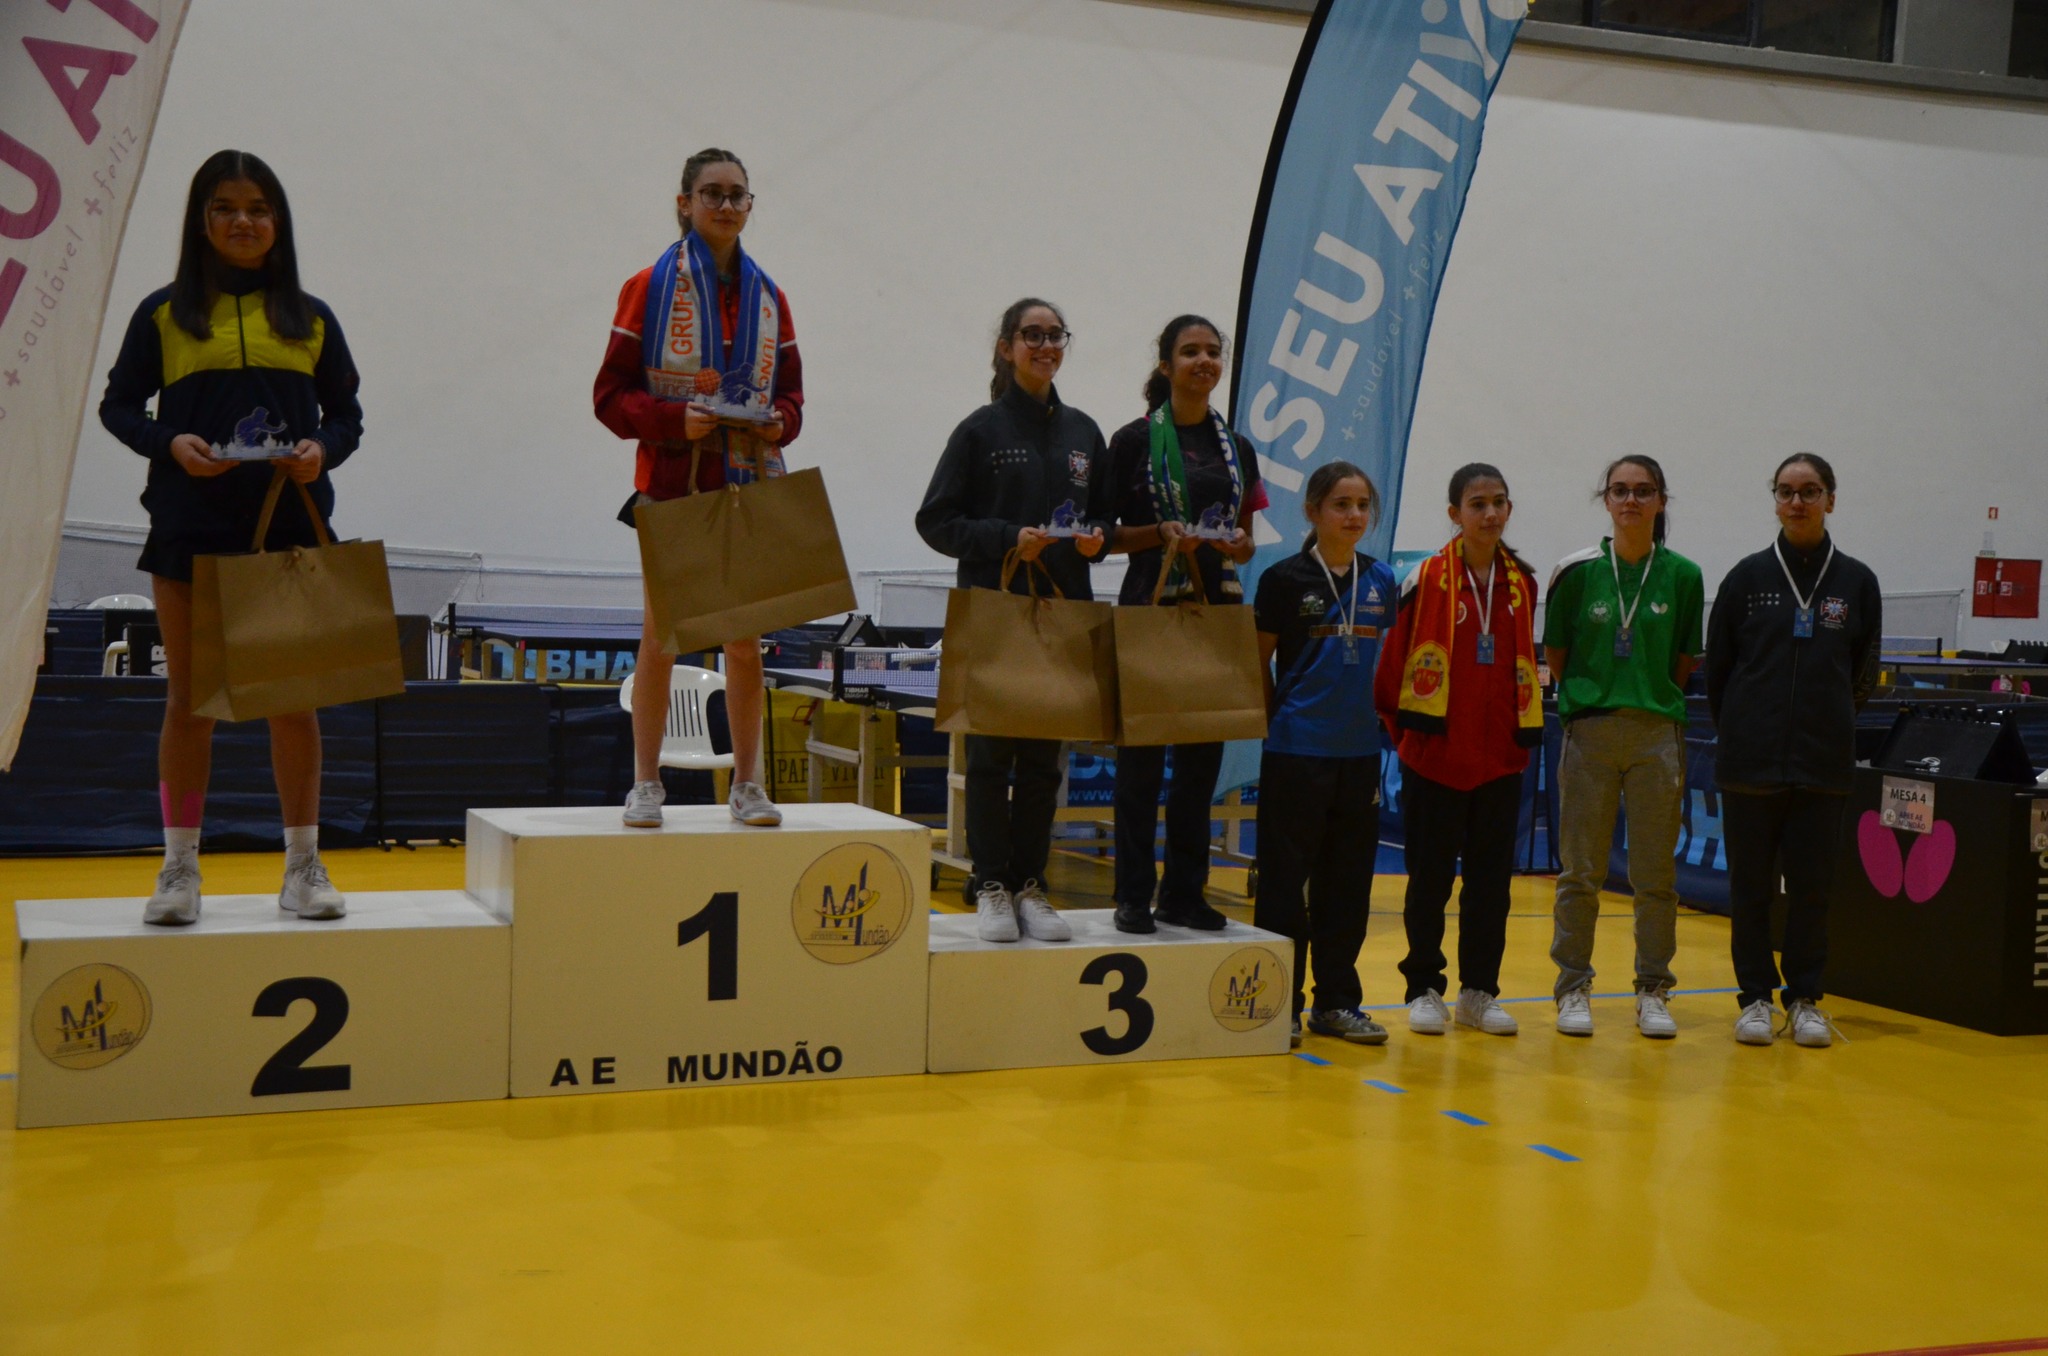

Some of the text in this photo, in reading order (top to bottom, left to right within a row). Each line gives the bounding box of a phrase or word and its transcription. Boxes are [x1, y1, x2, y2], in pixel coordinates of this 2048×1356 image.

[91, 124, 139, 202] feliz
[1250, 231, 1386, 547] ISEU
[492, 645, 641, 681] TIBHA
[1890, 788, 1927, 804] MESA 4
[677, 892, 738, 1001] 1
[251, 976, 351, 1096] 2
[1079, 952, 1155, 1056] 3
[667, 1040, 843, 1084] MUNDÃO
